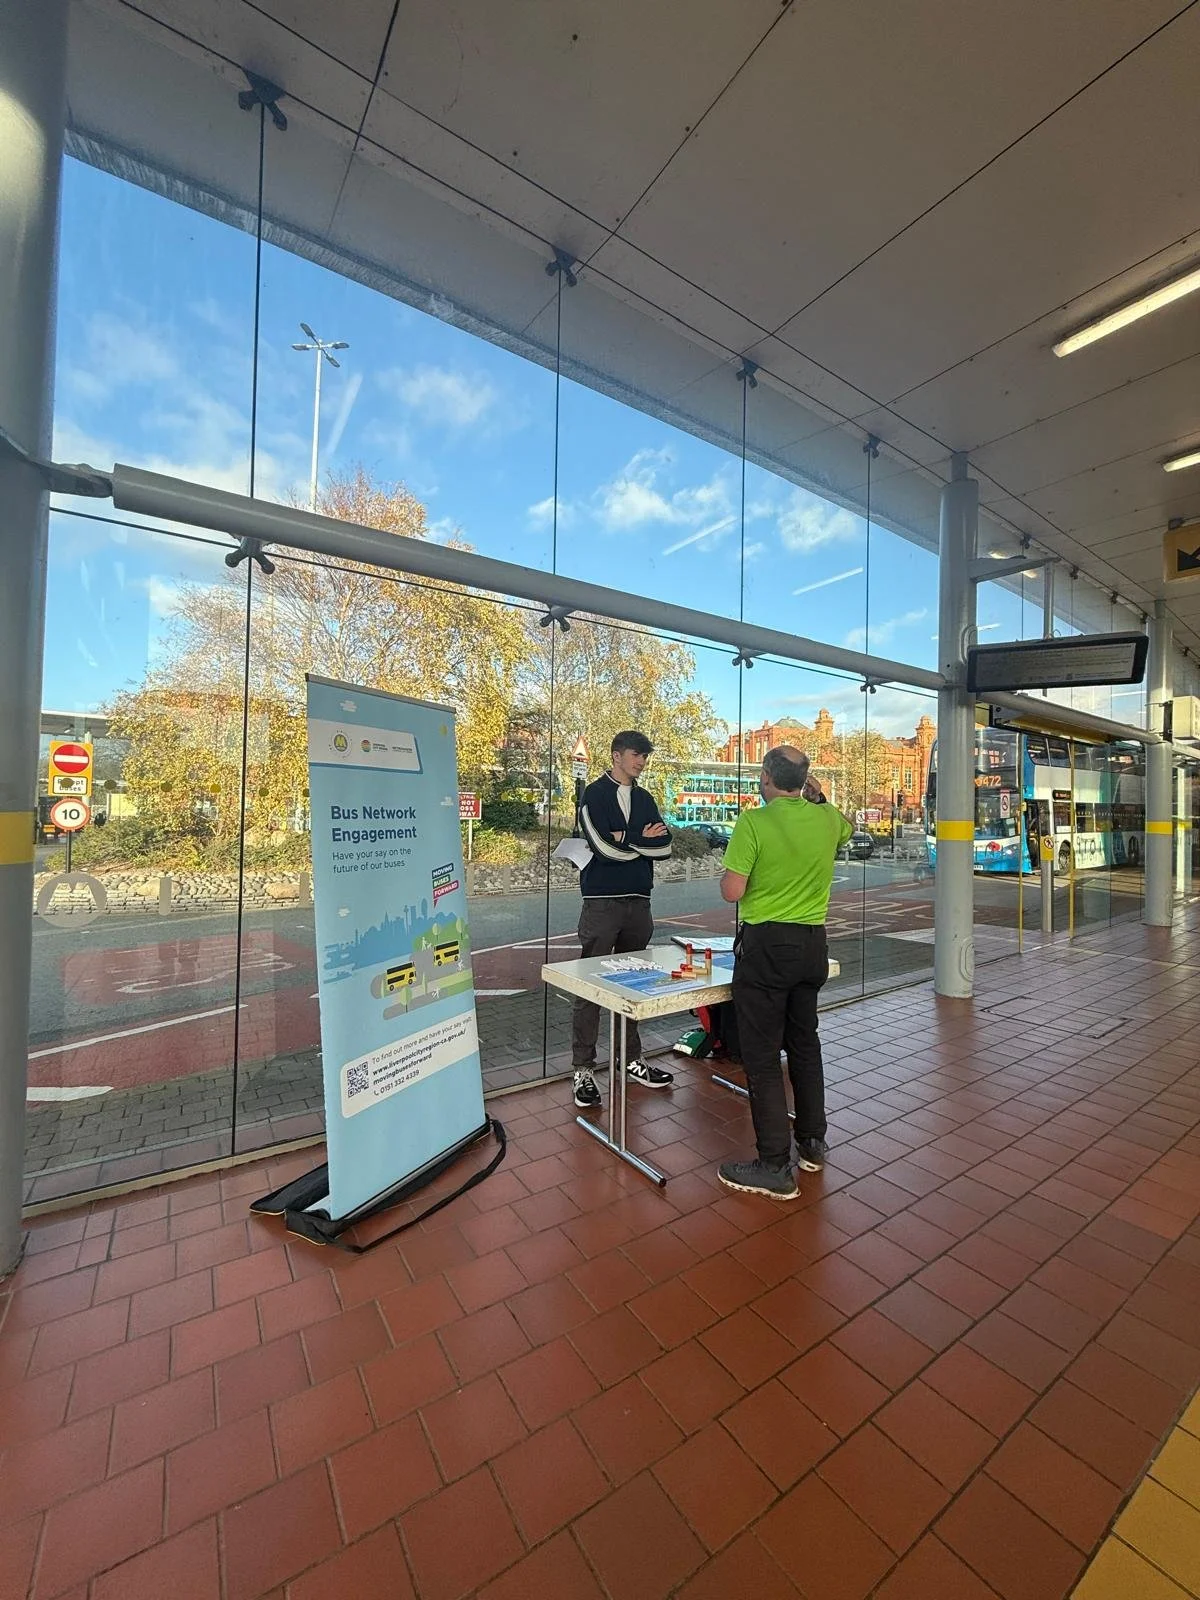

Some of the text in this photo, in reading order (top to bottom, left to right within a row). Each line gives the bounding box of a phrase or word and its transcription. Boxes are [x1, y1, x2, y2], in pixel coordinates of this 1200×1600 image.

[62, 808, 80, 820] 10
[331, 805, 416, 820] Bus Network
[332, 826, 418, 844] Engagement
[332, 847, 412, 861] Have your say on the
[333, 859, 406, 874] future of our buses
[433, 864, 454, 877] MOVING
[433, 876, 450, 888] BUSES
[434, 881, 458, 898] FORWARD
[372, 1056, 380, 1065] To
[381, 1050, 393, 1060] find
[393, 1046, 403, 1056] out
[403, 1040, 418, 1051] more
[418, 1035, 429, 1044] and
[373, 1053, 433, 1086] movingbusesforward
[380, 1082, 394, 1094] 0151
[394, 1076, 405, 1087] 332
